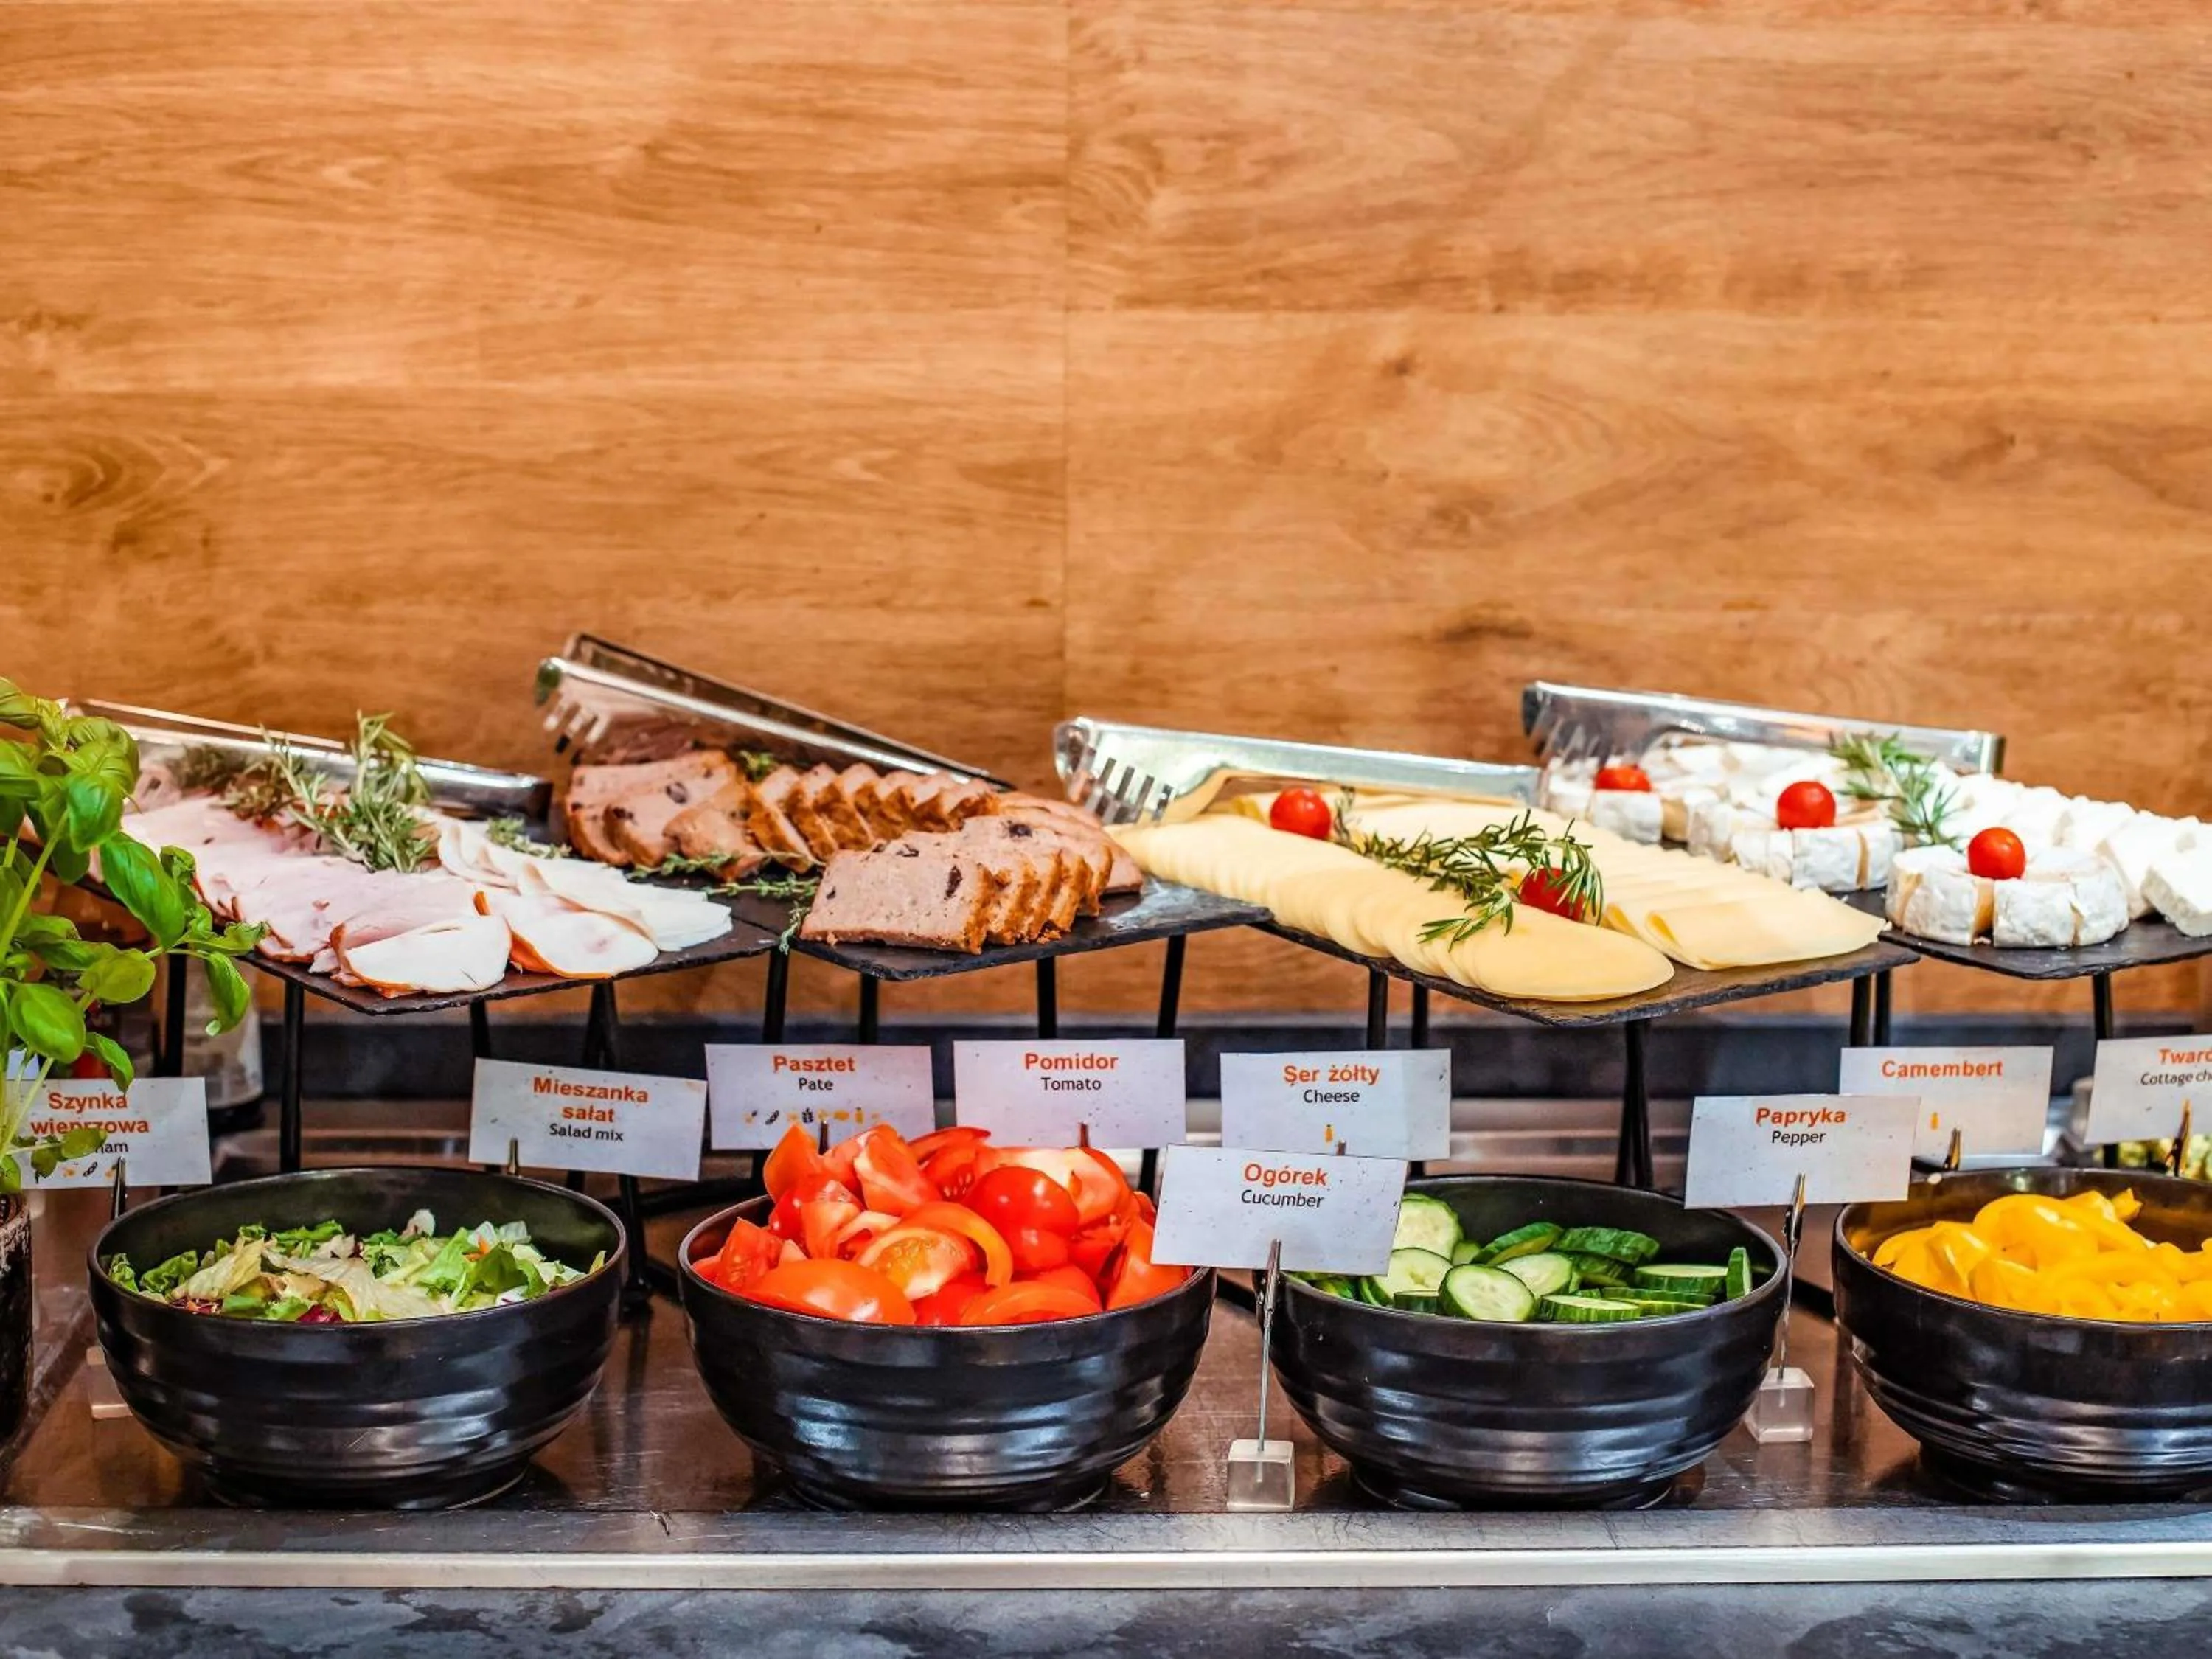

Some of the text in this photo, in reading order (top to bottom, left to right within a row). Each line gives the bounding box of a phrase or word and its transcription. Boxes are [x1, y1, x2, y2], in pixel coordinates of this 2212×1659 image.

[773, 1055, 855, 1072] Pasztet
[1025, 1052, 1119, 1071] Pomidor
[1882, 1060, 2003, 1078] Camembert
[799, 1077, 834, 1091] Pate
[1041, 1077, 1102, 1091] Tomato
[1328, 1064, 1380, 1086] żółty
[2140, 1071, 2193, 1087] Cottage
[533, 1076, 649, 1103] Mieszanka
[1304, 1089, 1360, 1104] Cheese
[48, 1091, 128, 1114] Szynka
[562, 1105, 616, 1123] sałat
[1756, 1107, 1846, 1127] Papryka
[549, 1123, 624, 1142] Salad mix
[1772, 1130, 1826, 1147] Pepper
[1244, 1163, 1328, 1187] Ogórek
[1241, 1189, 1325, 1208] Cucumber
